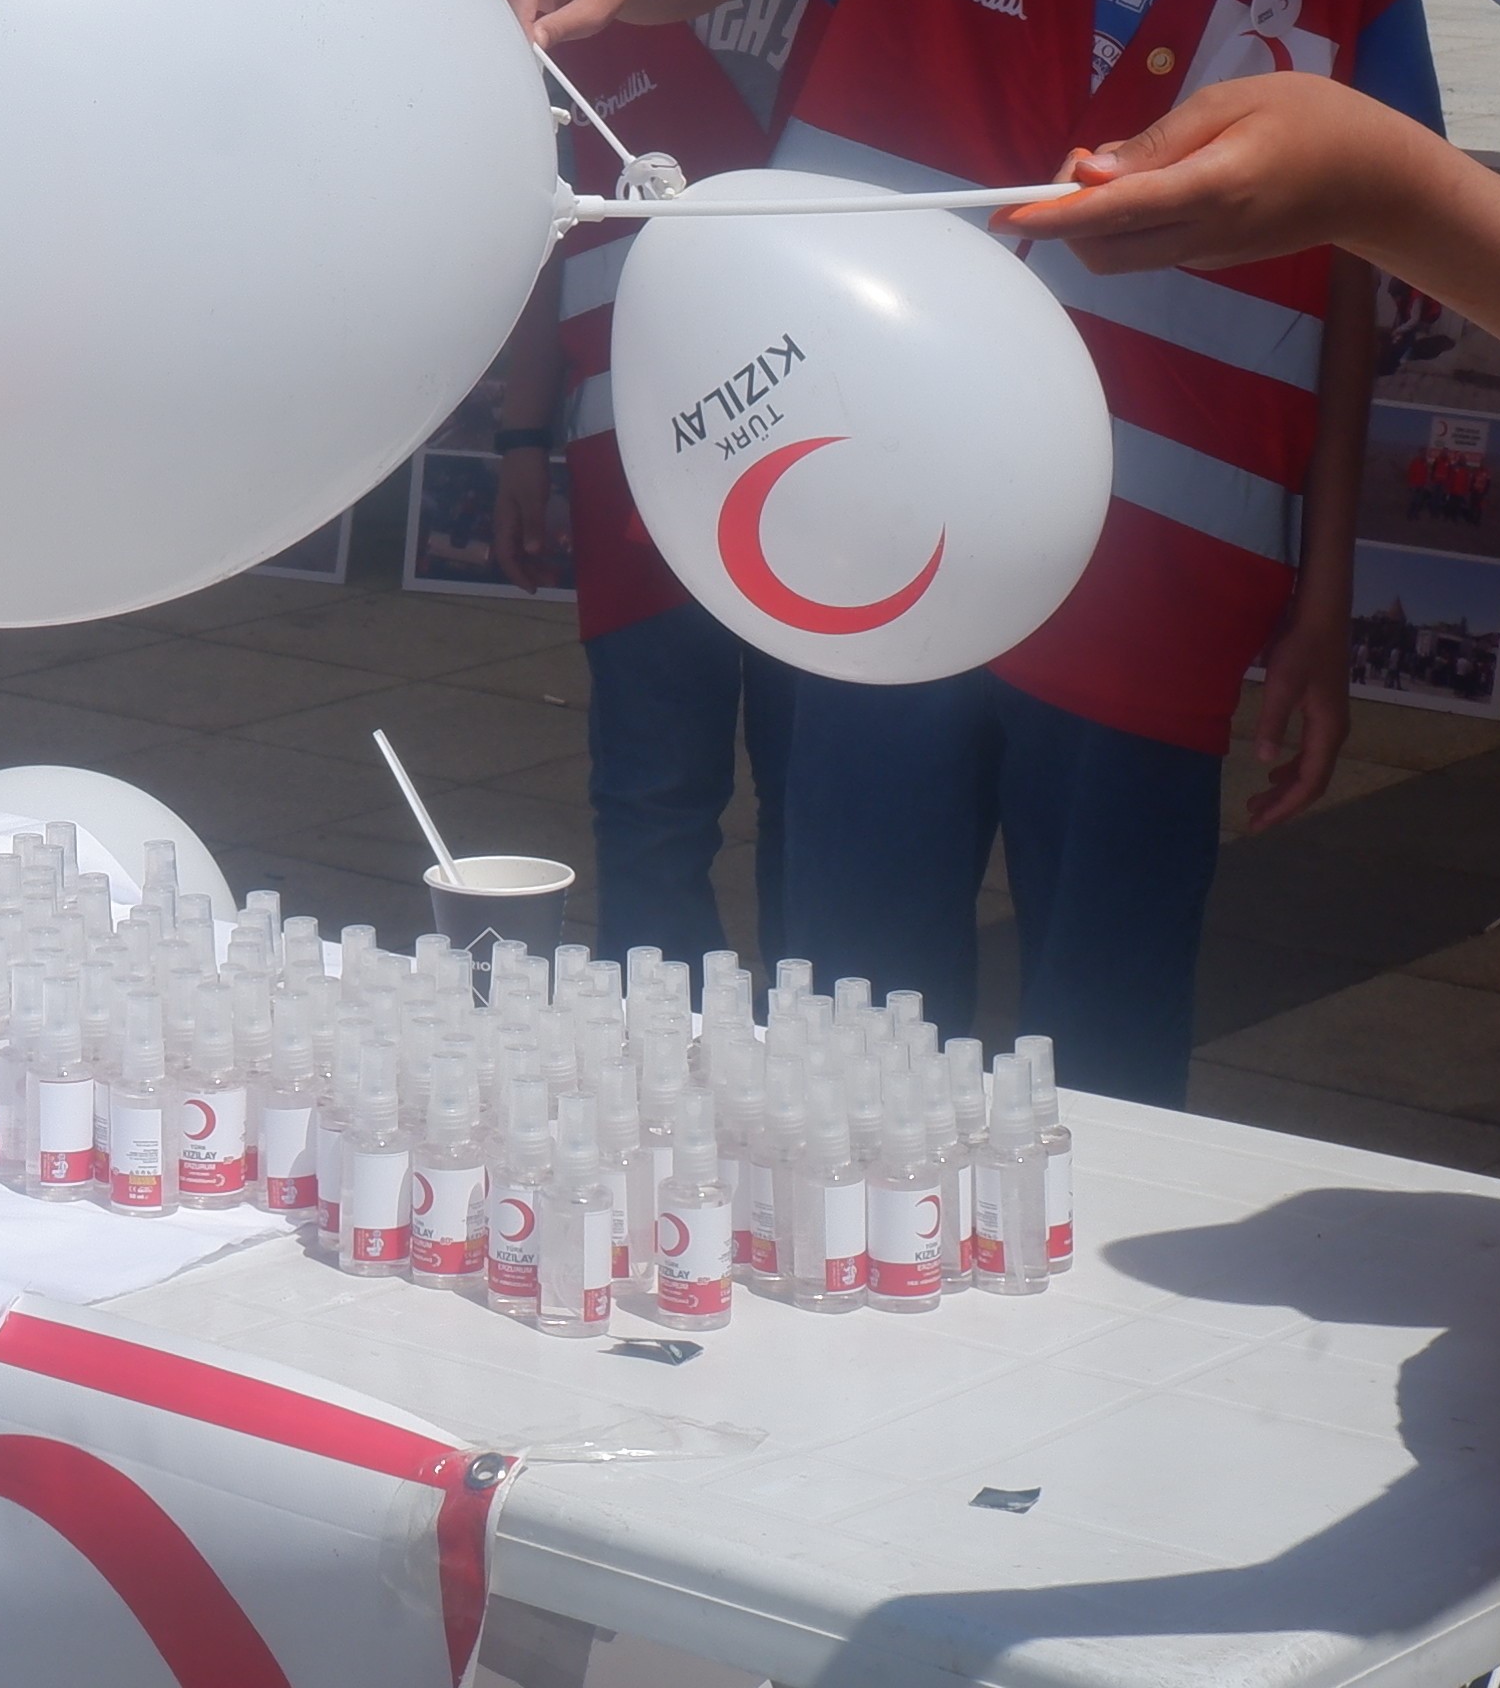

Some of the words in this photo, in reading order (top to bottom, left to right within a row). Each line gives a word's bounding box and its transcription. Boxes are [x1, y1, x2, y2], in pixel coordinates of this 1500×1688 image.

[671, 332, 806, 454] KIZILAY
[715, 403, 785, 462] TÜRK
[497, 1250, 535, 1263] KIZILAY
